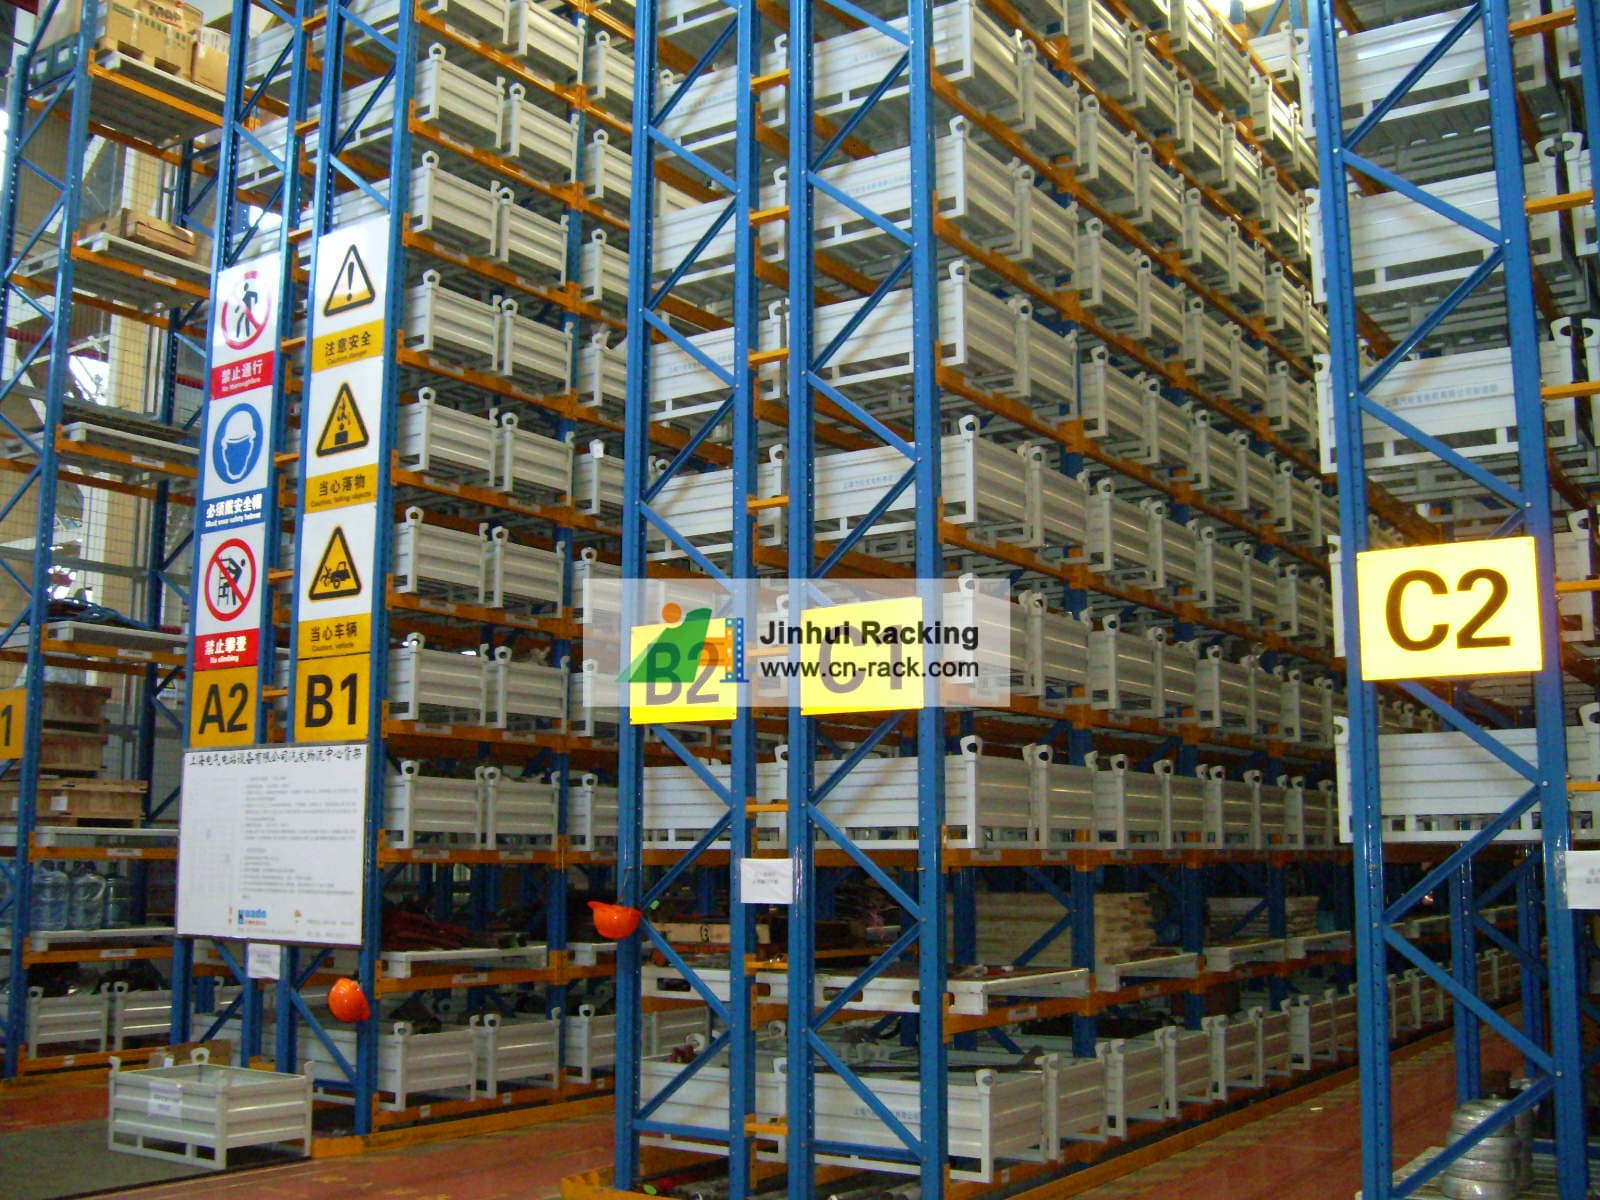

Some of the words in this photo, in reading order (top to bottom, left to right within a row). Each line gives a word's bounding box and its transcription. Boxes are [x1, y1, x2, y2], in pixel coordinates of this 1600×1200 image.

[325, 330, 371, 356] 注意安全
[221, 359, 264, 384] 禁止通行
[319, 473, 365, 496] 当心落物
[1385, 568, 1512, 652] C2
[204, 635, 248, 656] 禁止攀登
[311, 621, 357, 642] 当心车辆
[645, 641, 720, 706] B2
[818, 623, 903, 694] C1
[198, 682, 249, 735] A2
[304, 673, 358, 728] B1
